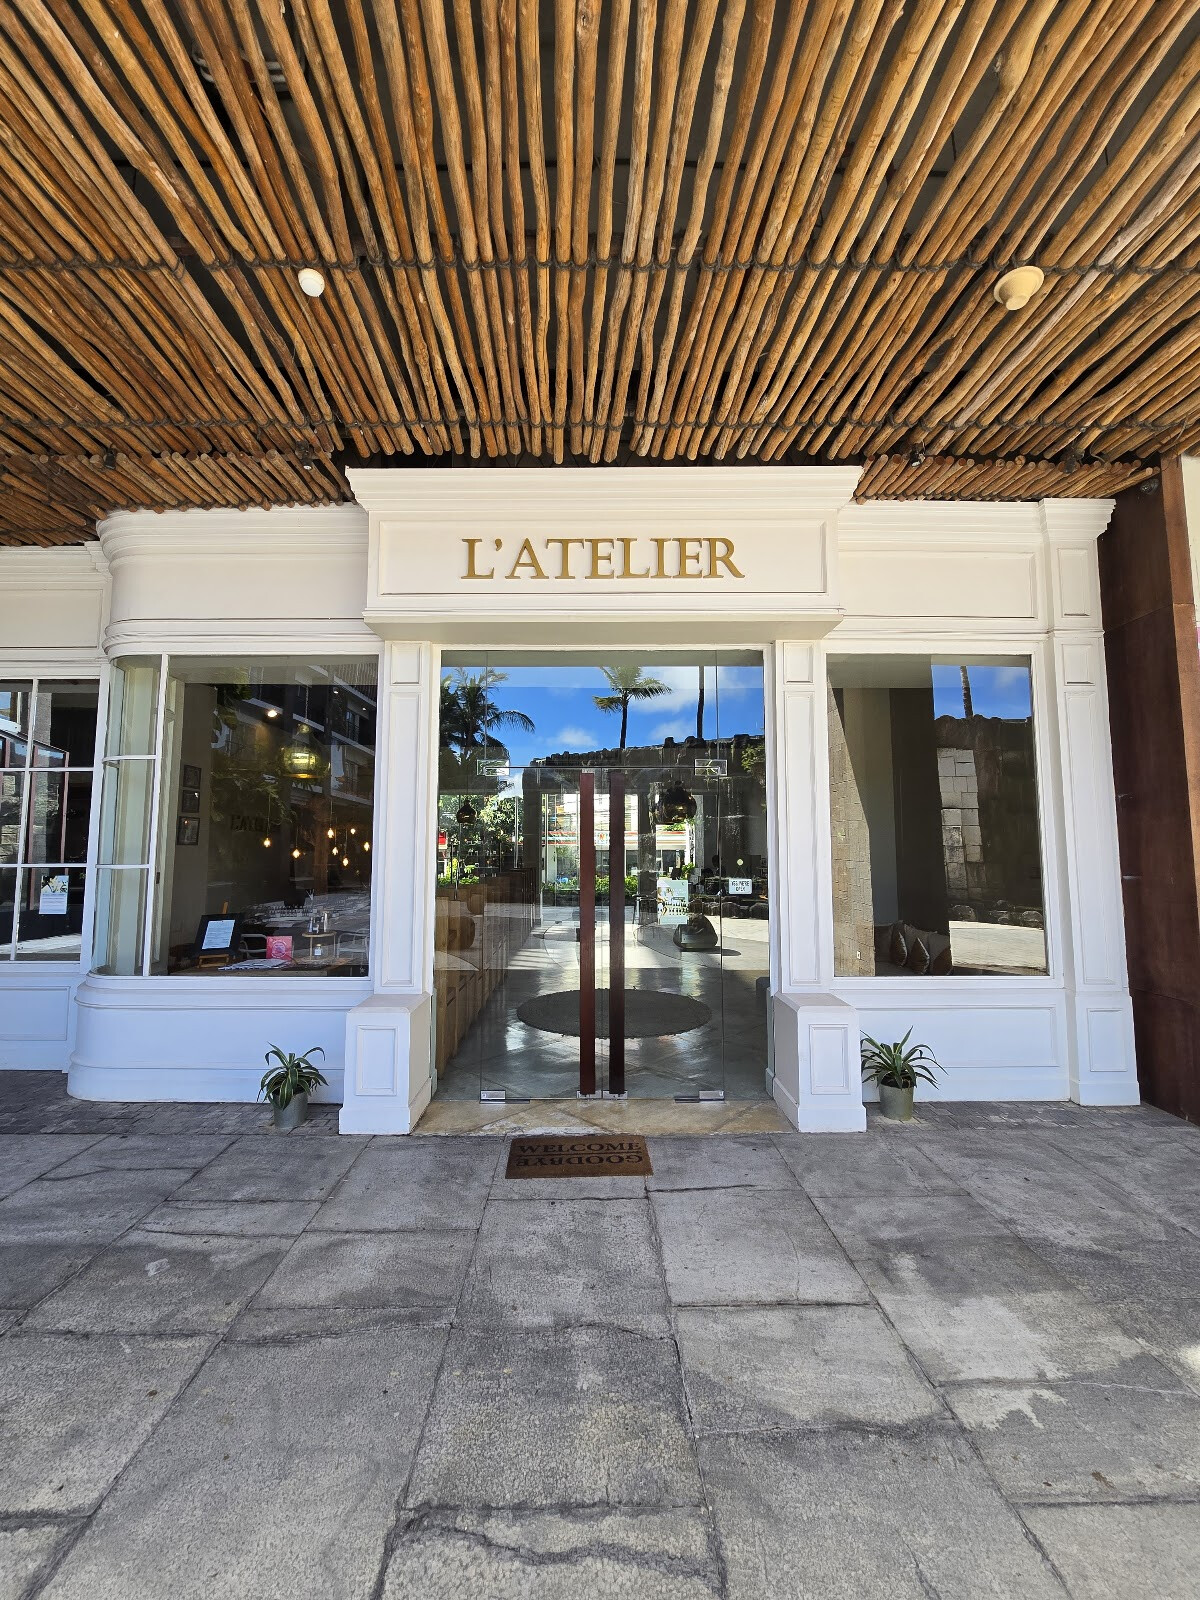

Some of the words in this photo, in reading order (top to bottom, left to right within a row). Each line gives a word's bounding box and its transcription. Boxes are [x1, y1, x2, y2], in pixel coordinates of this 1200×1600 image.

[461, 537, 745, 580] L'ATELIER
[516, 1142, 642, 1154] WELCOME
[515, 1154, 644, 1167] GOODBYE
